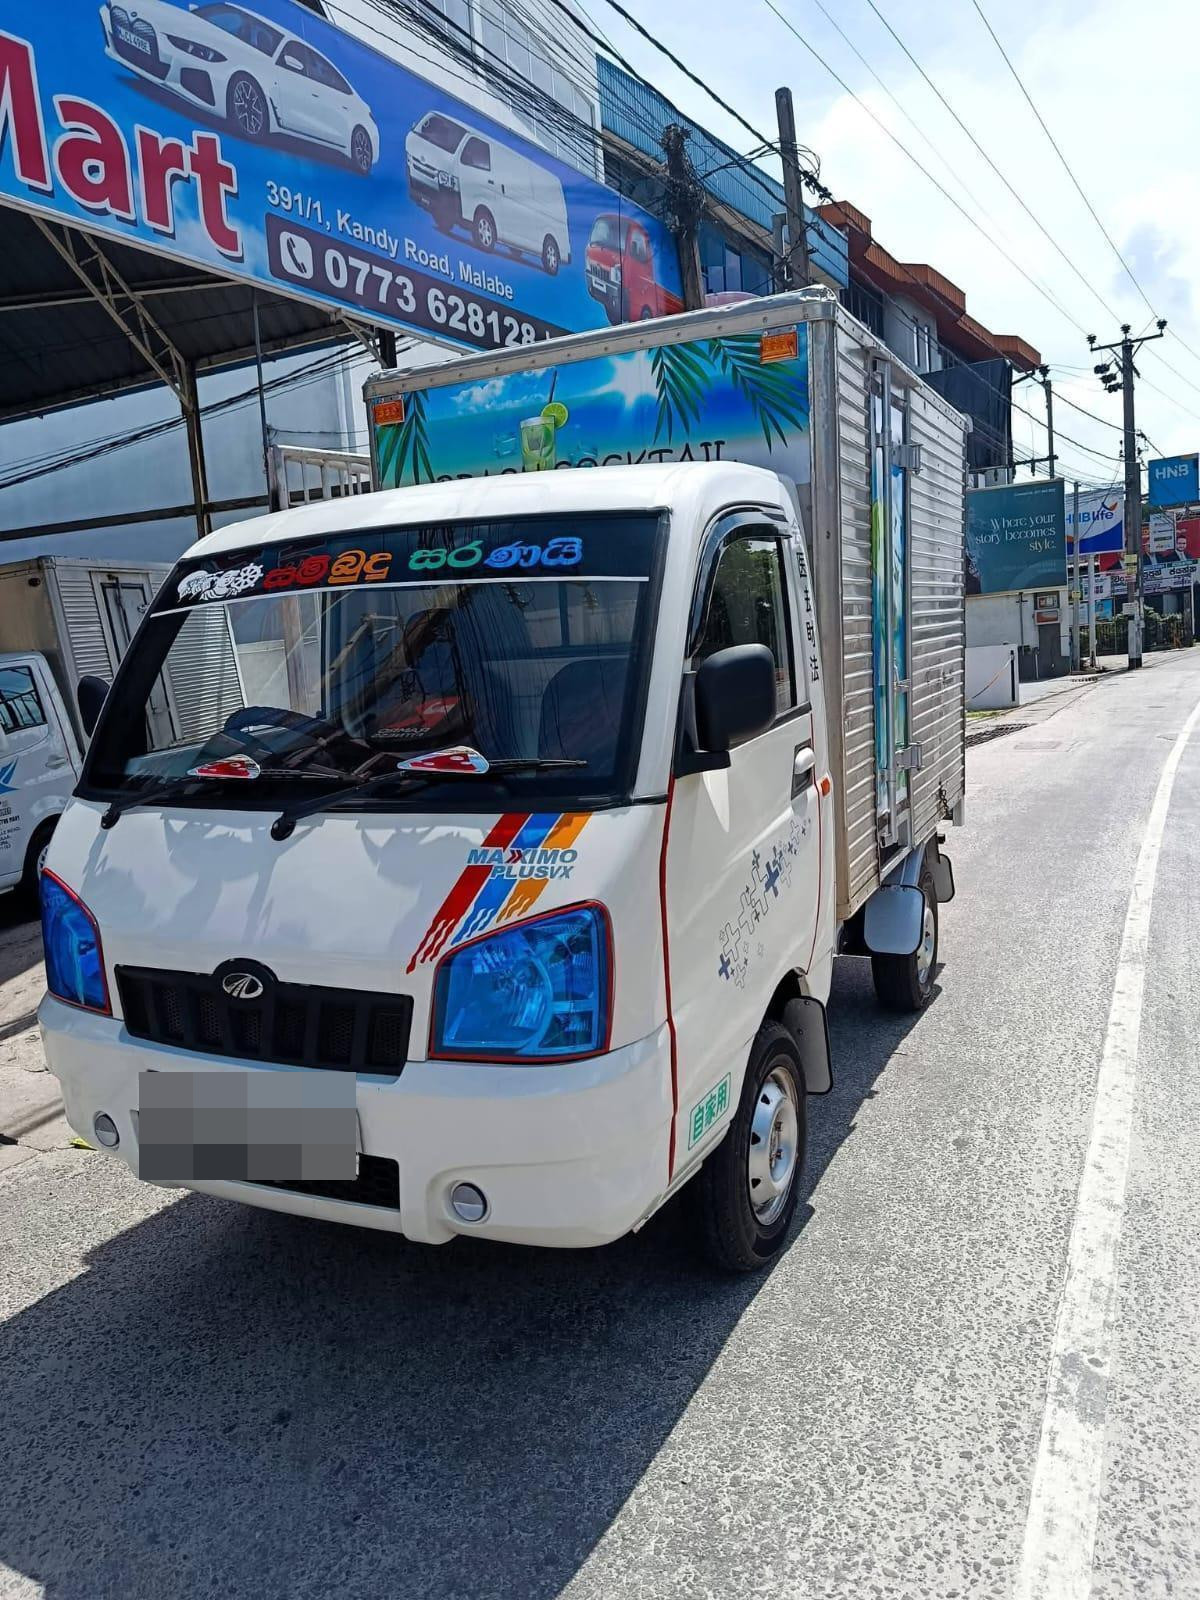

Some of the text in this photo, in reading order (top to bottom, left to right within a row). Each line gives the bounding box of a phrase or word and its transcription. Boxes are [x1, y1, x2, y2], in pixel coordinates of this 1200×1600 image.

[265, 179, 514, 301] 391/1, Kandy Road, Malabe
[324, 248, 536, 347] 0773 628128
[1155, 464, 1189, 480] HNB
[990, 513, 1056, 530] Where your
[975, 527, 1056, 545] story becomes
[408, 536, 583, 571] සරණයි
[466, 848, 578, 865] MAXIMO
[693, 1080, 728, 1141] 自家用
